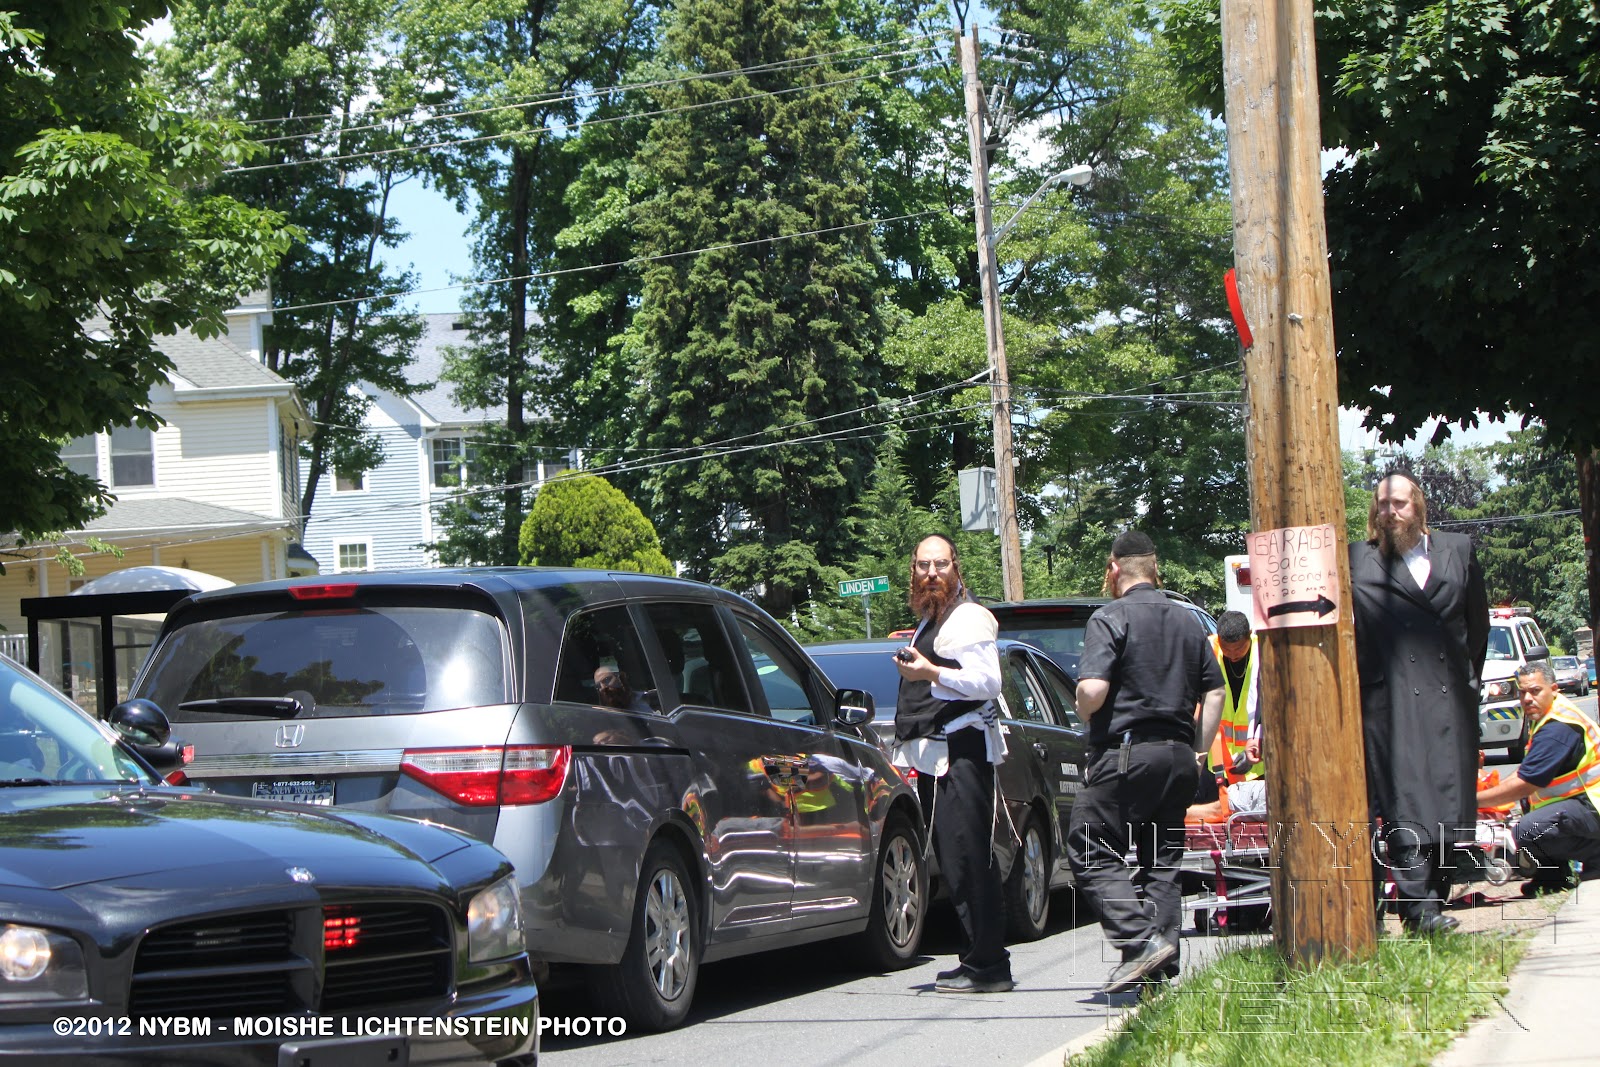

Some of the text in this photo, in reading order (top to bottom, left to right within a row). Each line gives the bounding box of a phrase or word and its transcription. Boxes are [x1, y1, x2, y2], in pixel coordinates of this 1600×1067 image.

[1254, 527, 1333, 556] GARAGE
[1266, 555, 1309, 574] Sale
[1271, 571, 1322, 587] Second
[840, 580, 875, 595] LINDEN
[273, 785, 315, 795] NEW YORK
